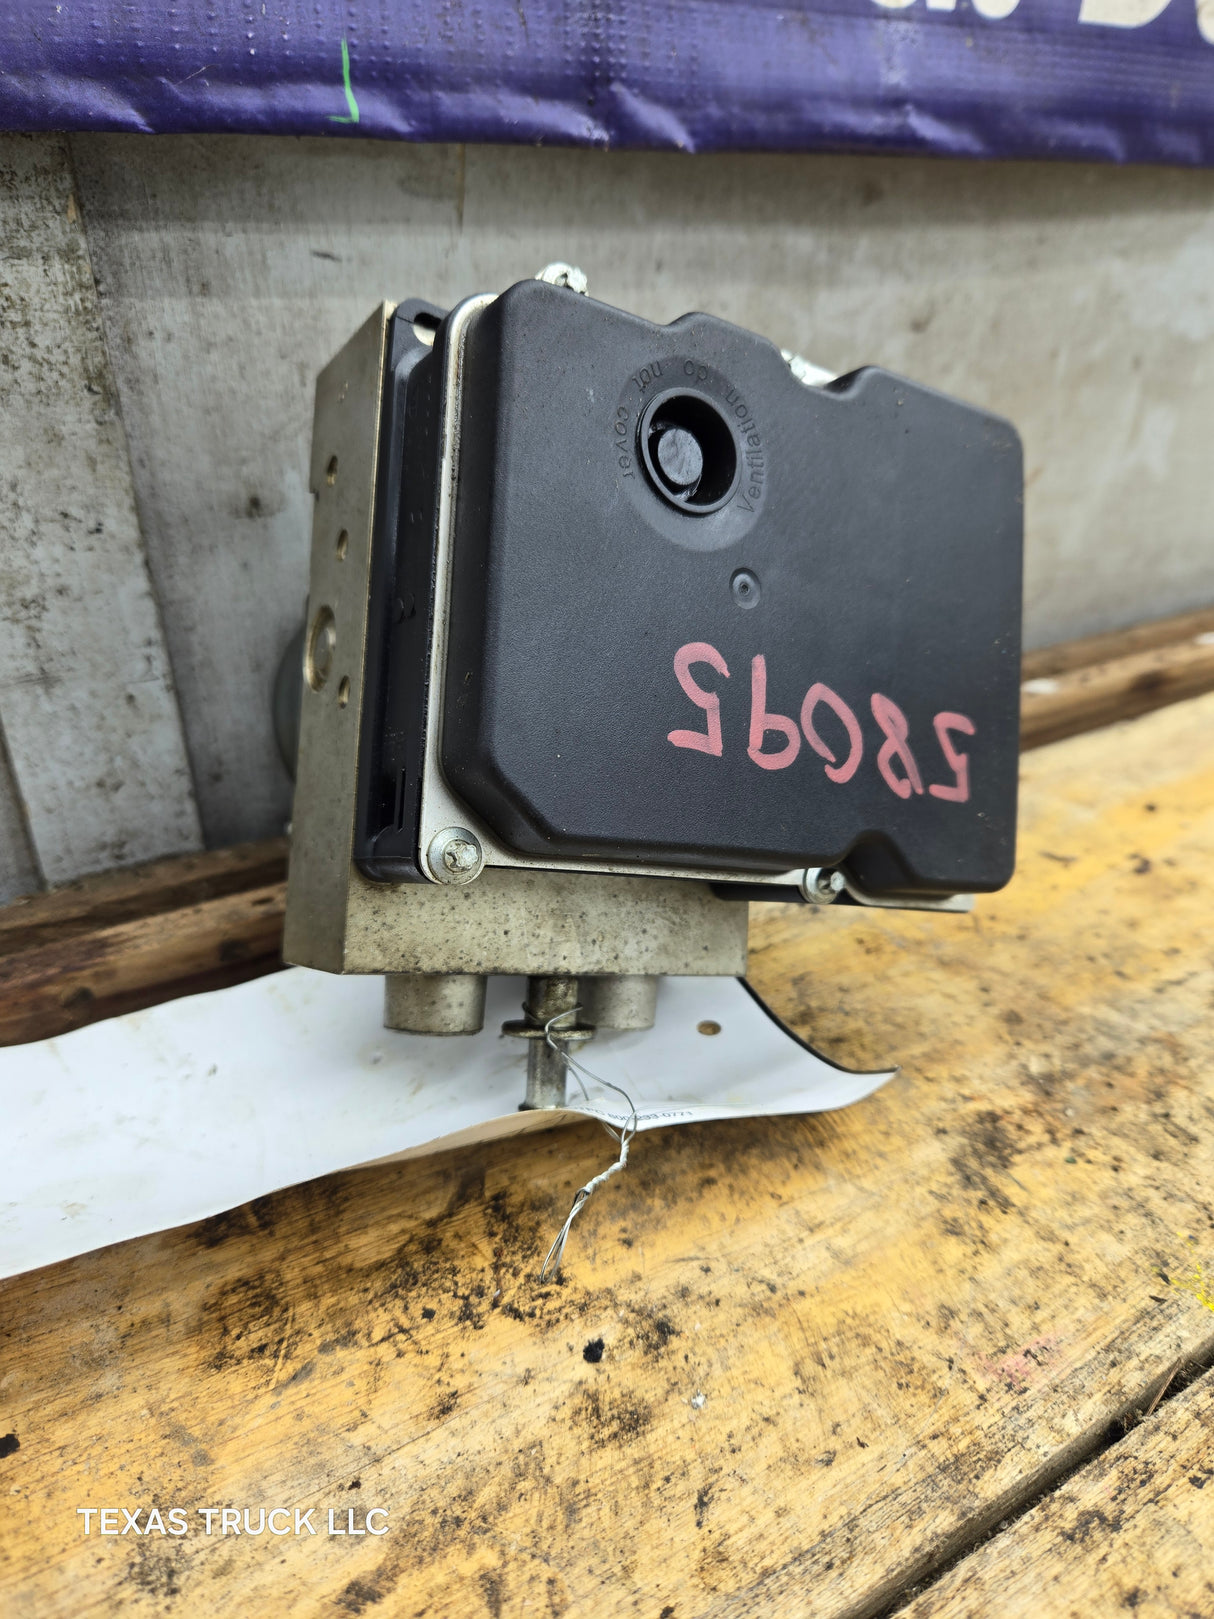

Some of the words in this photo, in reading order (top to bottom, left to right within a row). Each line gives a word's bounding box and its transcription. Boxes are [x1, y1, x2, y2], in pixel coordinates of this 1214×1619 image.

[632, 360, 664, 393] not
[683, 359, 709, 383] do
[615, 406, 636, 480] cover
[725, 388, 765, 513] Ventilation
[667, 641, 976, 803] 58095
